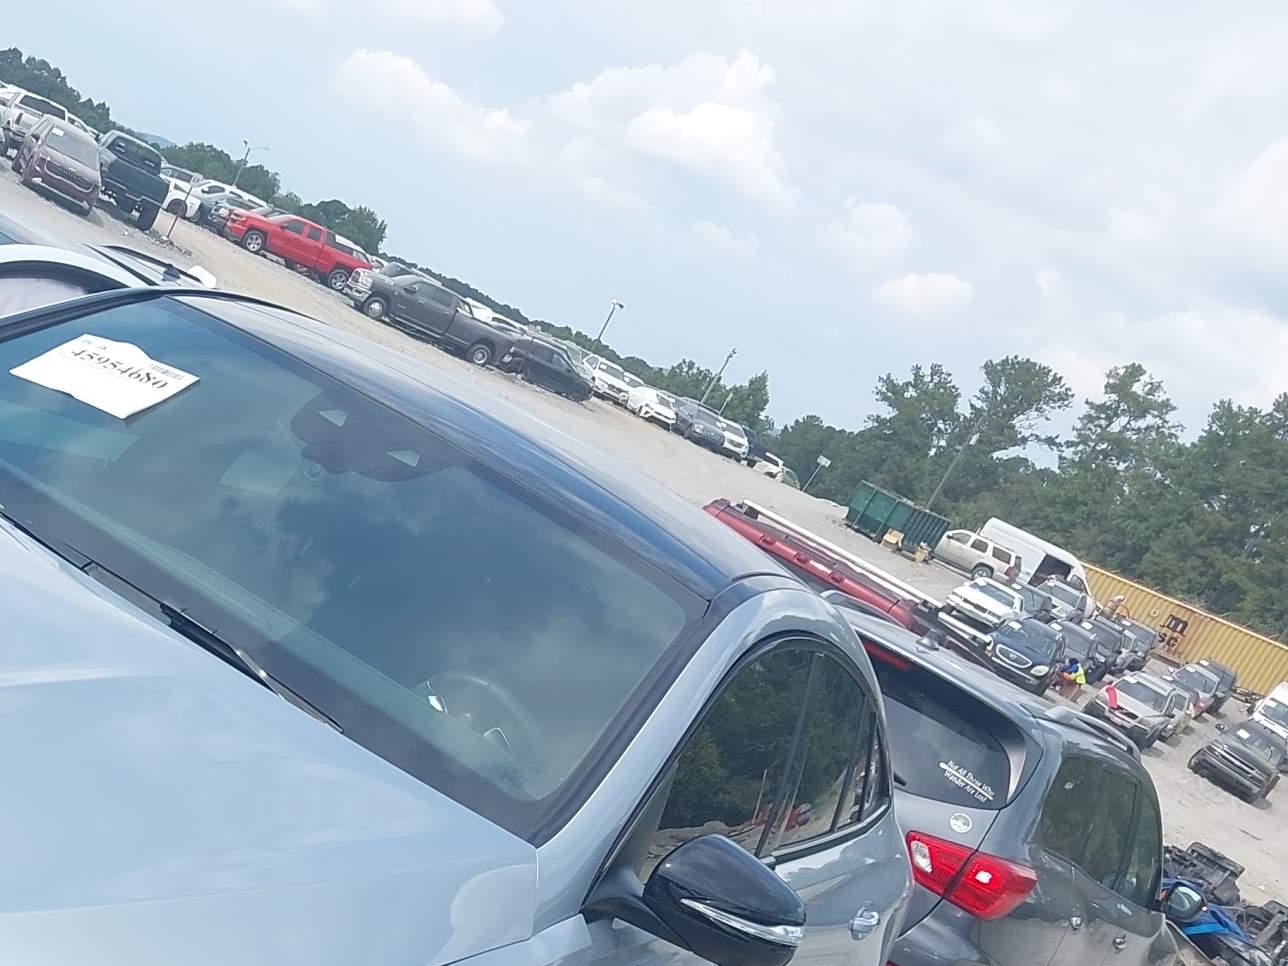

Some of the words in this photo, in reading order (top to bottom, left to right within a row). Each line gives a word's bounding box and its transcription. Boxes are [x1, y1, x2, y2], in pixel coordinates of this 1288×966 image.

[71, 348, 169, 389] 45954680
[943, 769, 964, 788] Wander
[964, 784, 975, 795] Are
[974, 791, 987, 803] Lost
[947, 760, 959, 770] Not
[966, 772, 982, 787] Those
[982, 783, 995, 796] Who
